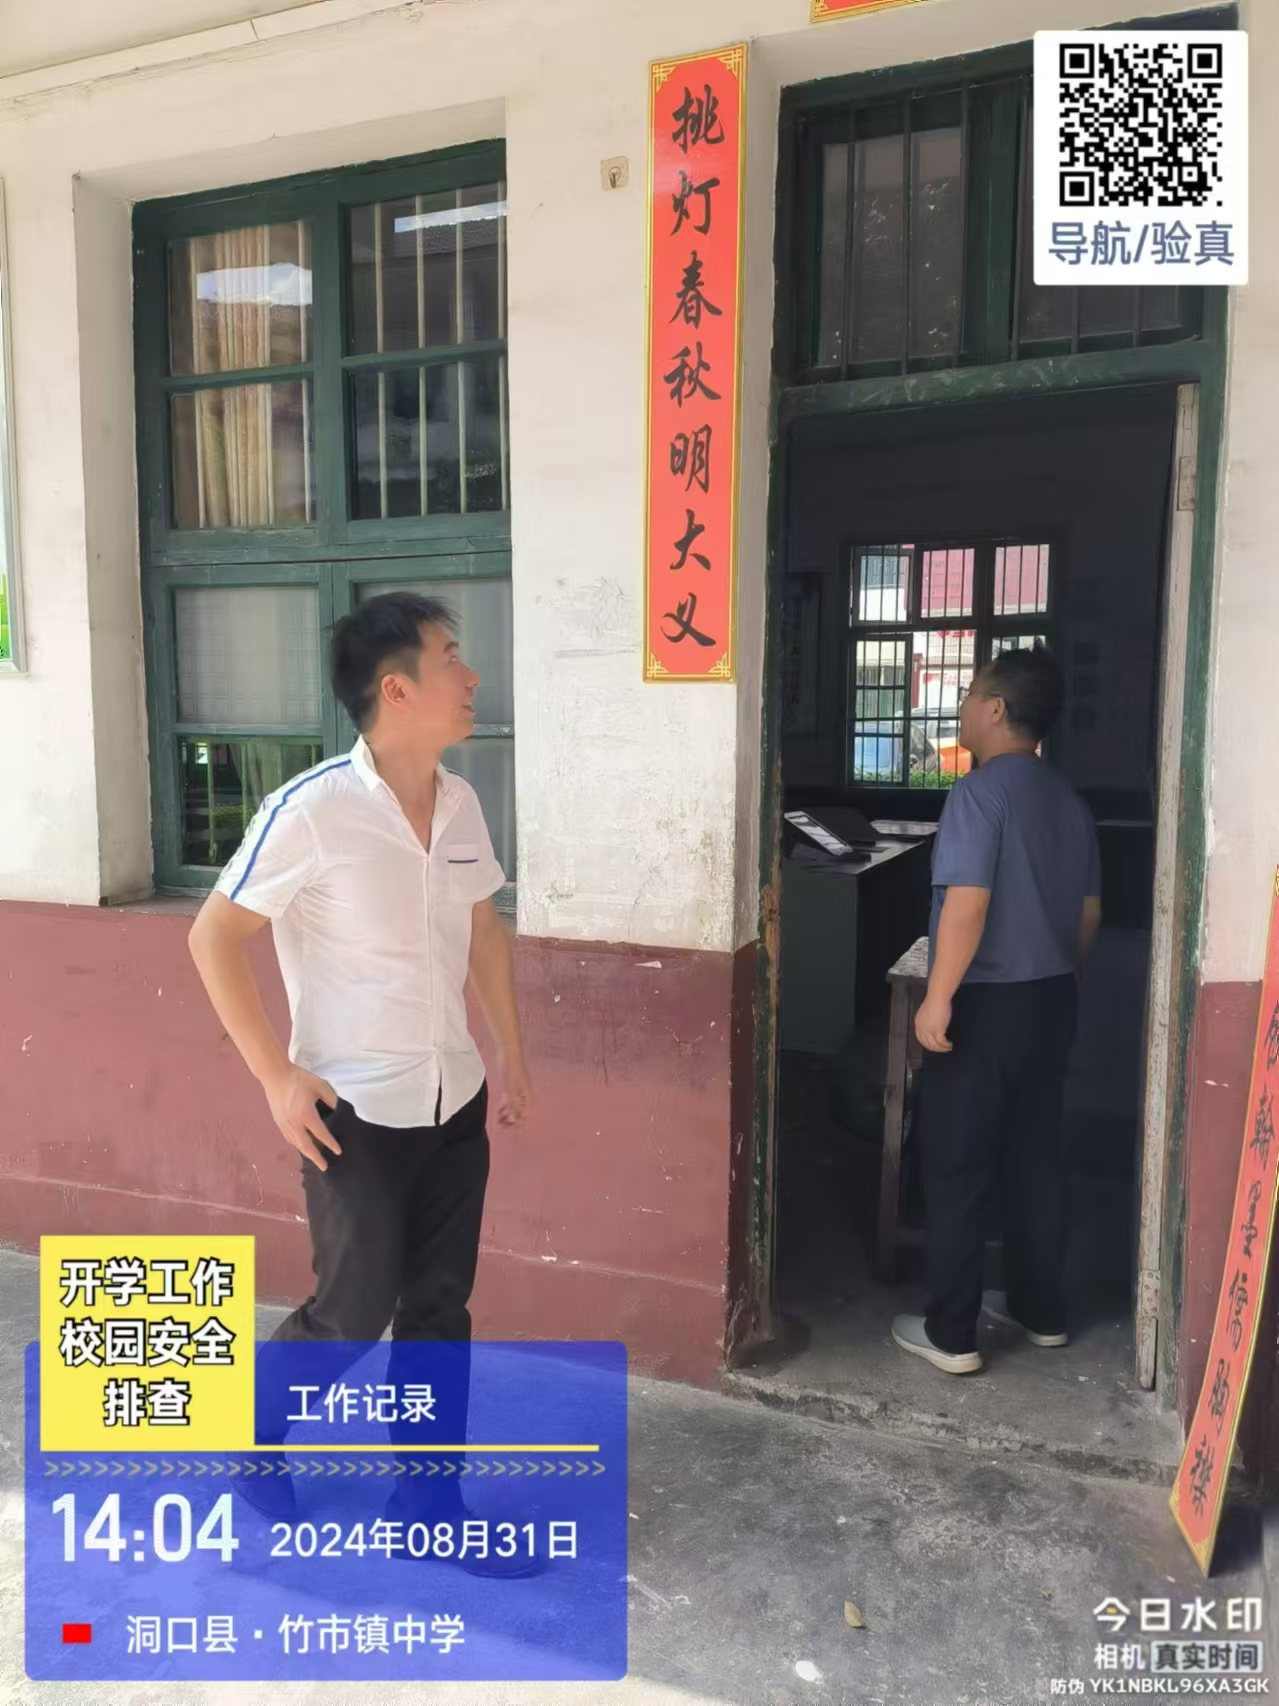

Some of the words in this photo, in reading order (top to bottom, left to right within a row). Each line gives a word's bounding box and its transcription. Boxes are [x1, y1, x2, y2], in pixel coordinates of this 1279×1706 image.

[660, 83, 725, 648] 挑灯春秋明大义
